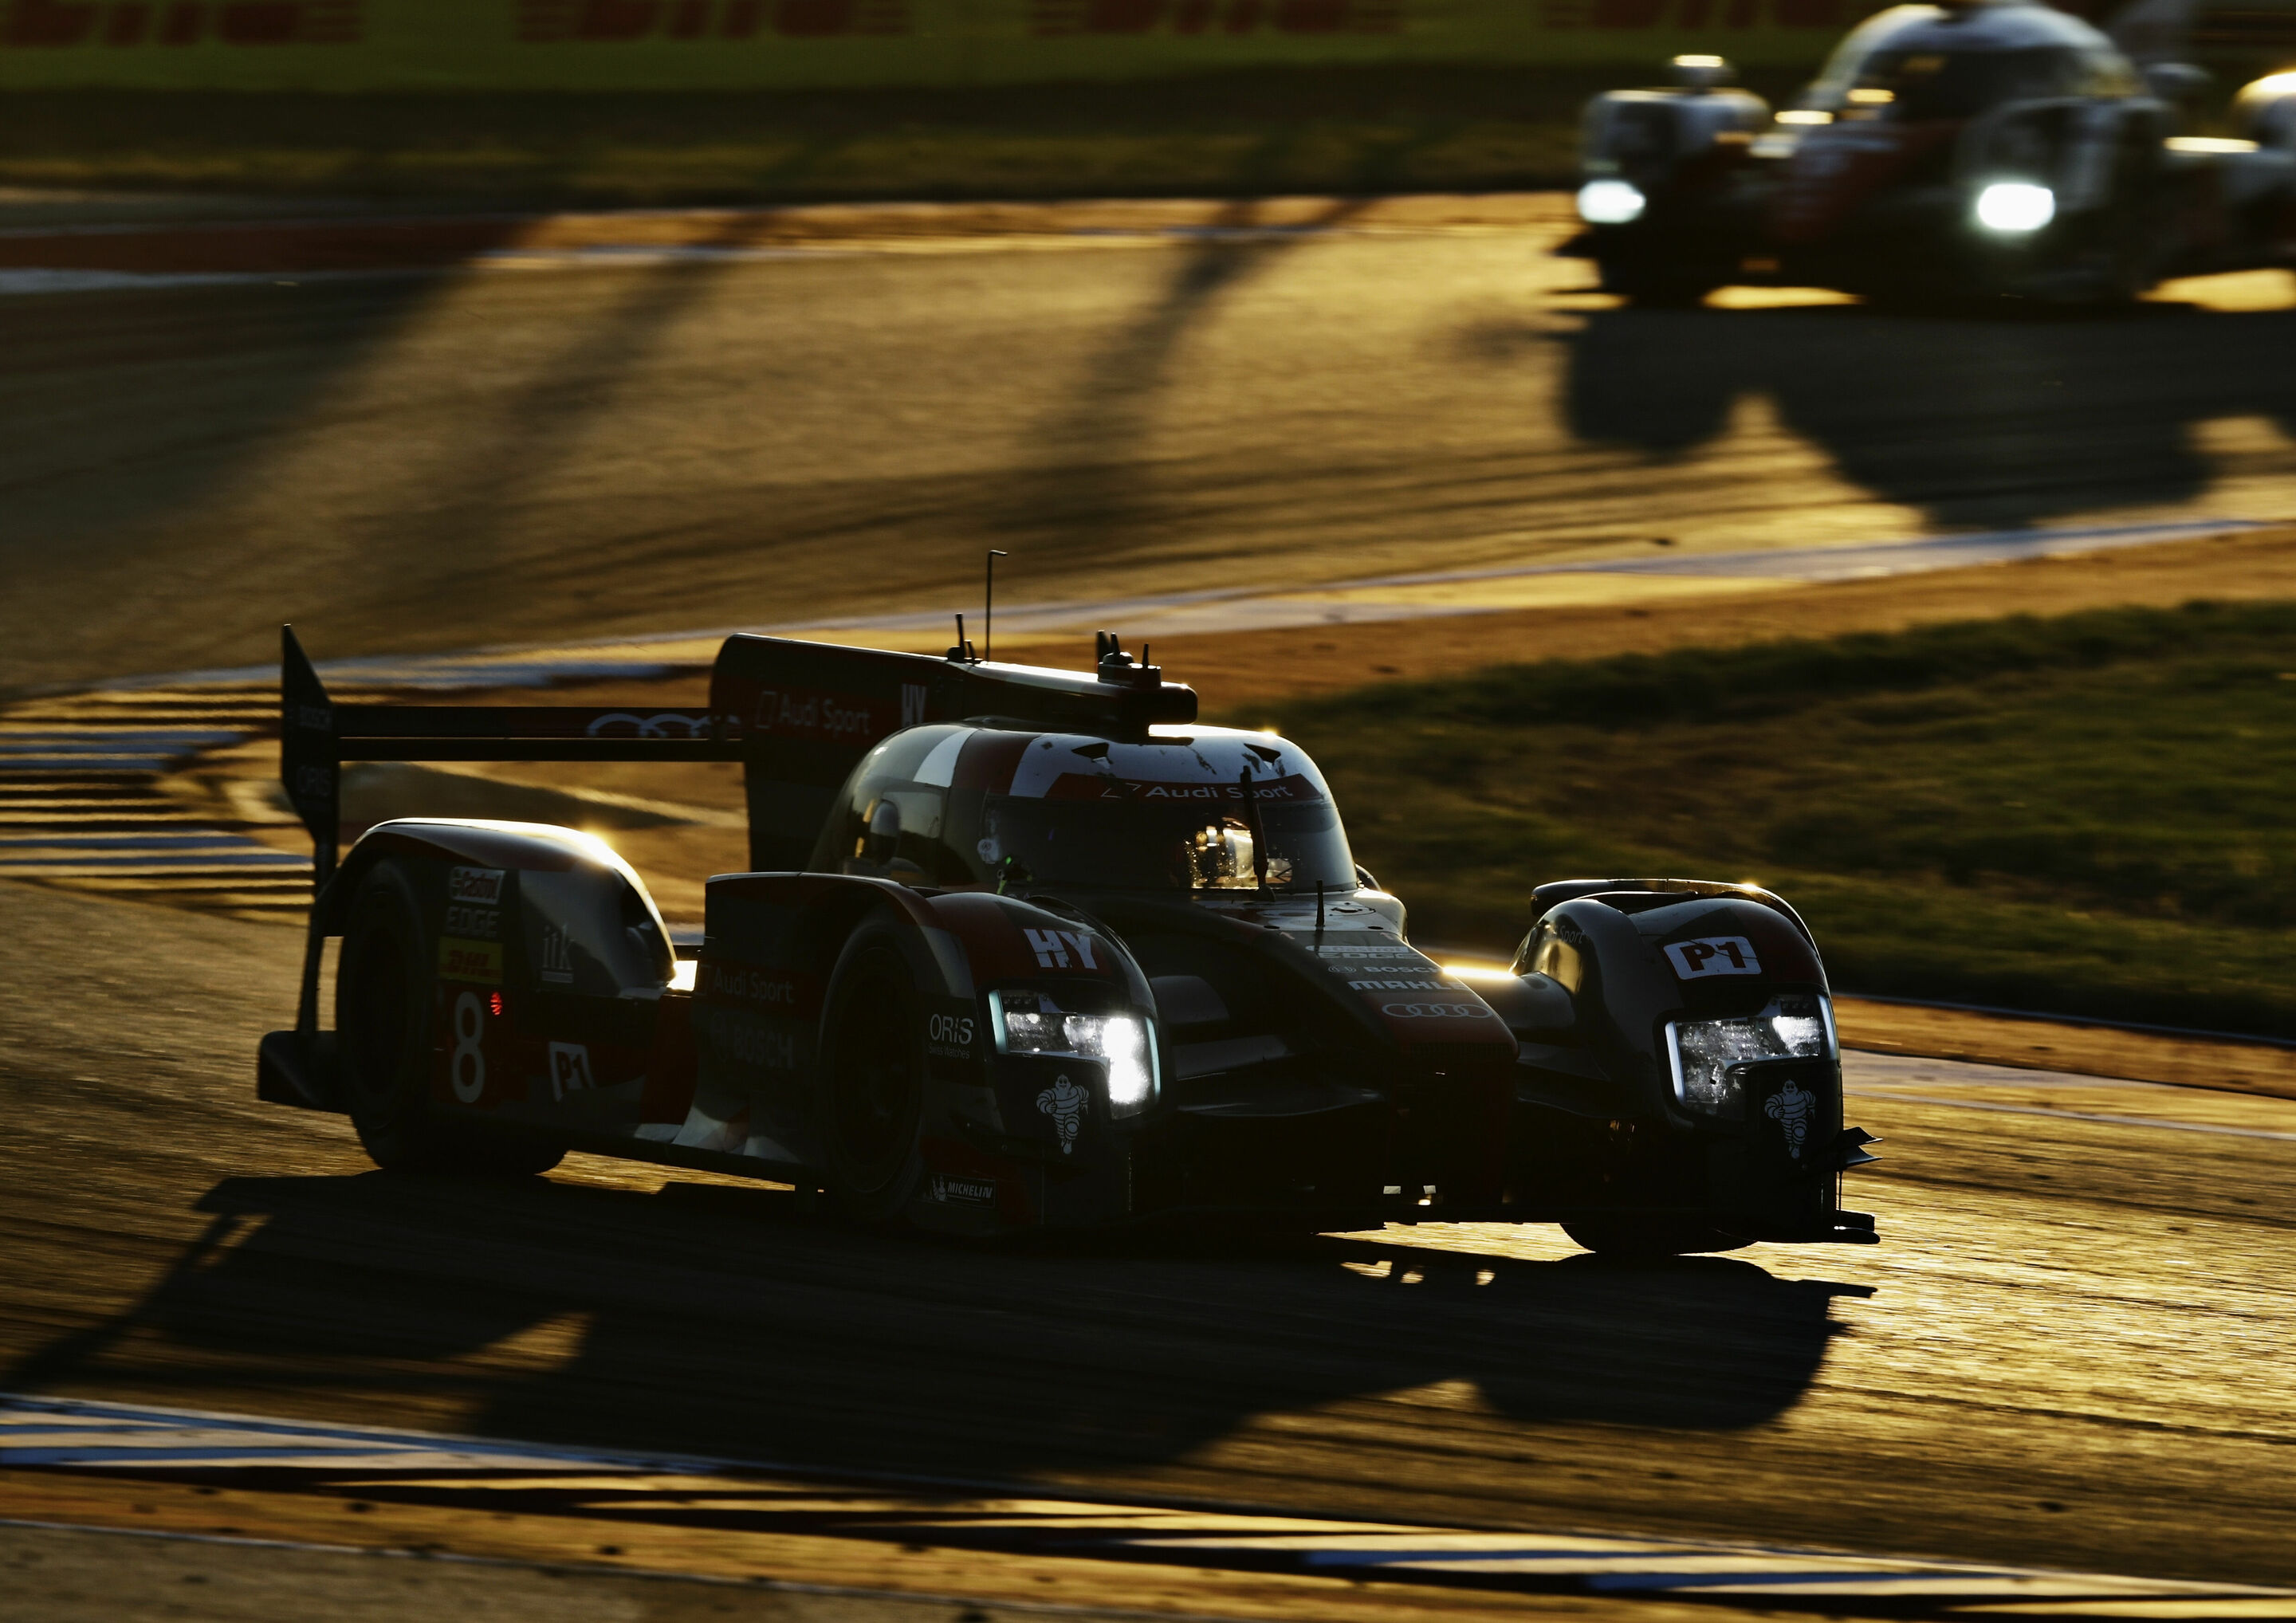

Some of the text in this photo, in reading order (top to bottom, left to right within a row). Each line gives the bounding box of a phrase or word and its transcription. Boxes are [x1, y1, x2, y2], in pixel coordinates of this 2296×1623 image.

[777, 693, 871, 740] Audi Sport
[1145, 785, 1219, 799] Audi
[446, 906, 503, 939] EDGE
[1023, 928, 1098, 970] HY
[1680, 941, 1746, 972] P1
[713, 965, 796, 1005] Audi Sport
[1348, 980, 1469, 991] MAHLE
[930, 1013, 974, 1046] ORIS
[452, 991, 486, 1103] 8
[556, 1050, 591, 1094] P1
[947, 1180, 993, 1199] MICHELIN
